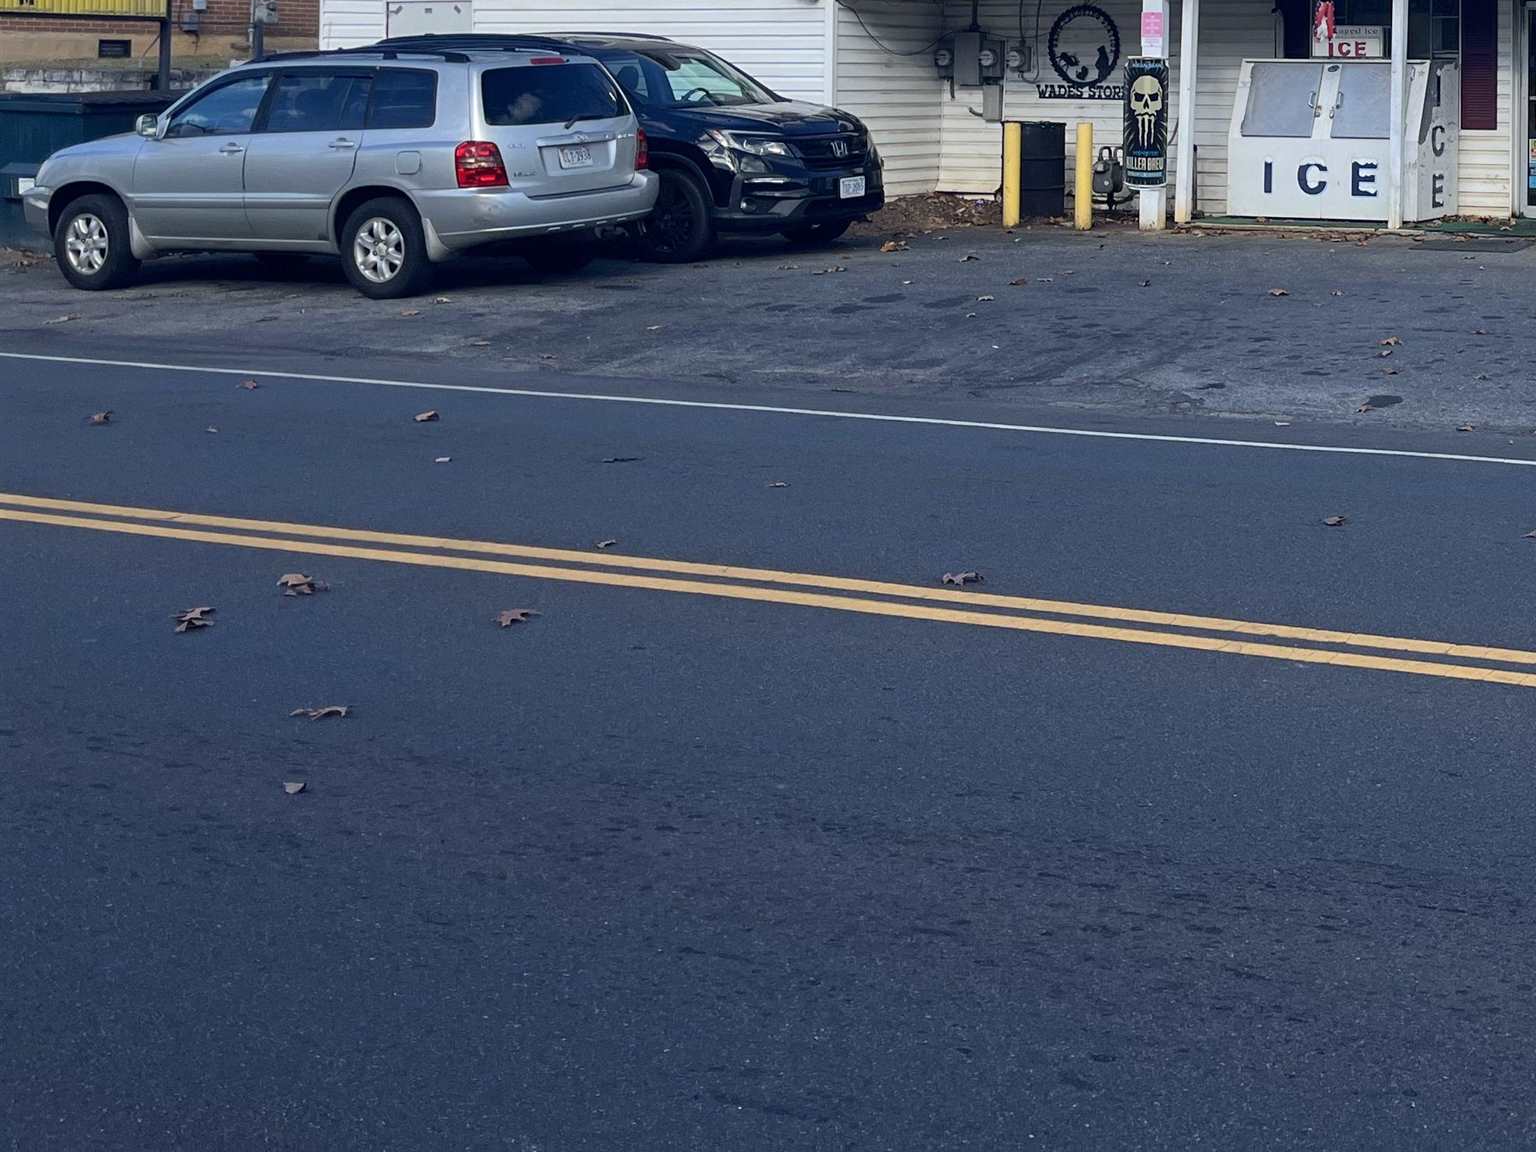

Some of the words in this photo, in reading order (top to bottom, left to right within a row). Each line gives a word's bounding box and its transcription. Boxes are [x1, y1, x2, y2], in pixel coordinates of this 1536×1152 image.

[1328, 40, 1367, 58] ICE
[1037, 84, 1084, 98] WADES
[1263, 156, 1378, 196] ICE
